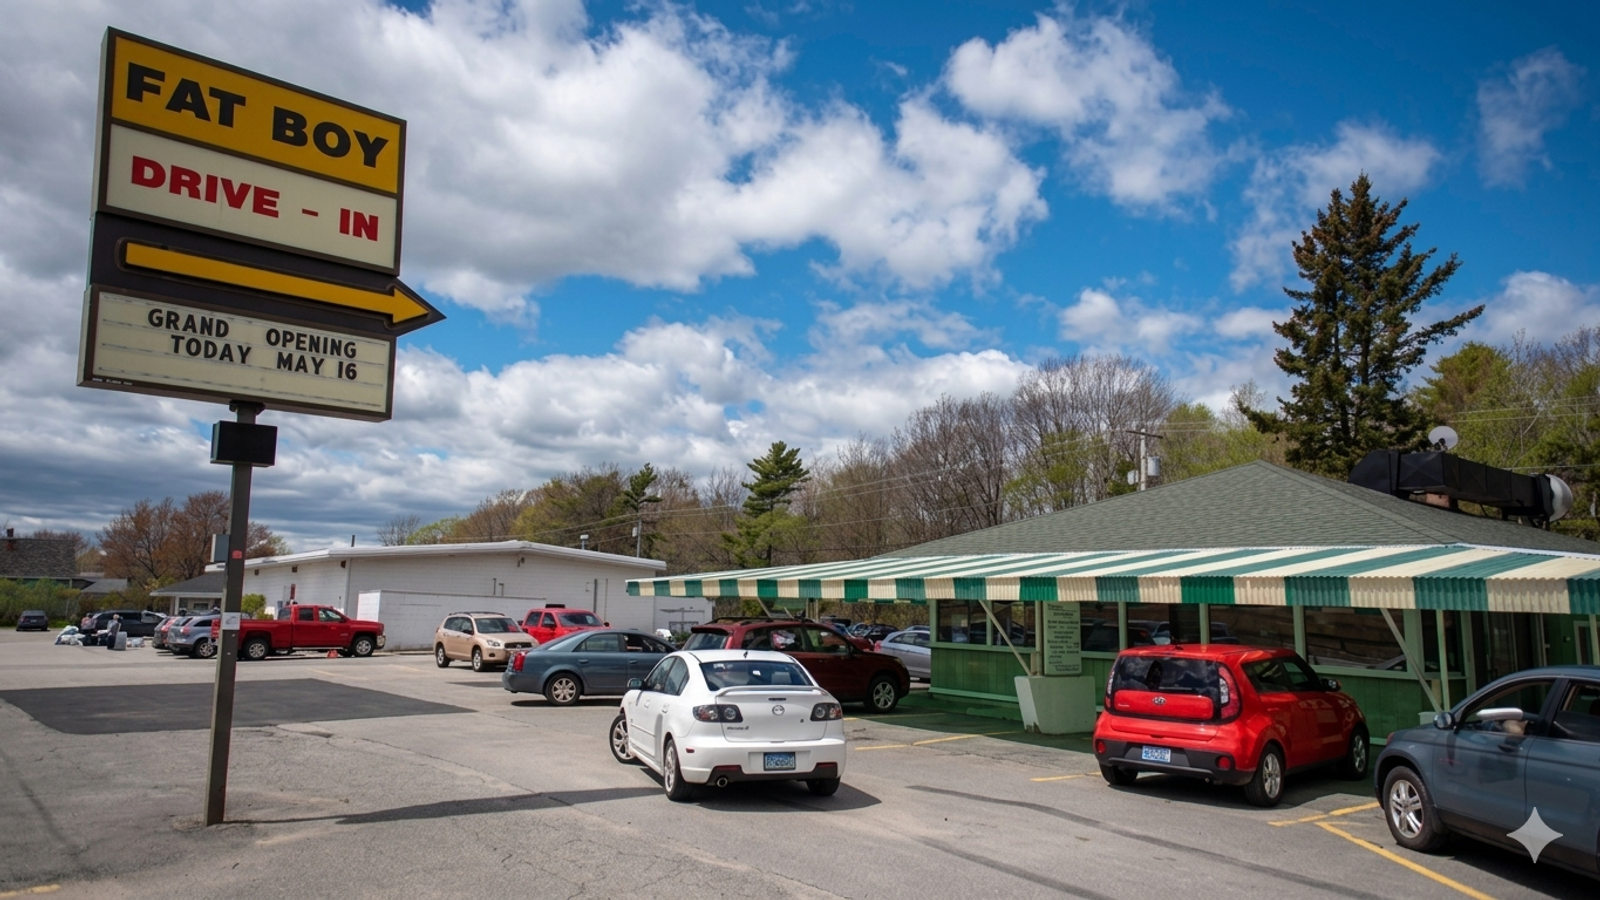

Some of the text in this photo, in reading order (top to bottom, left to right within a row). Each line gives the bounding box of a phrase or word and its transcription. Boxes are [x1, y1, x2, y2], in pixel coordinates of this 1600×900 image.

[126, 62, 389, 168] FAT BOY
[131, 156, 280, 218] DRIVE
[339, 208, 379, 241] IN
[147, 309, 357, 358] GRAND OPENING
[171, 335, 357, 380] TODAY MAY 16
